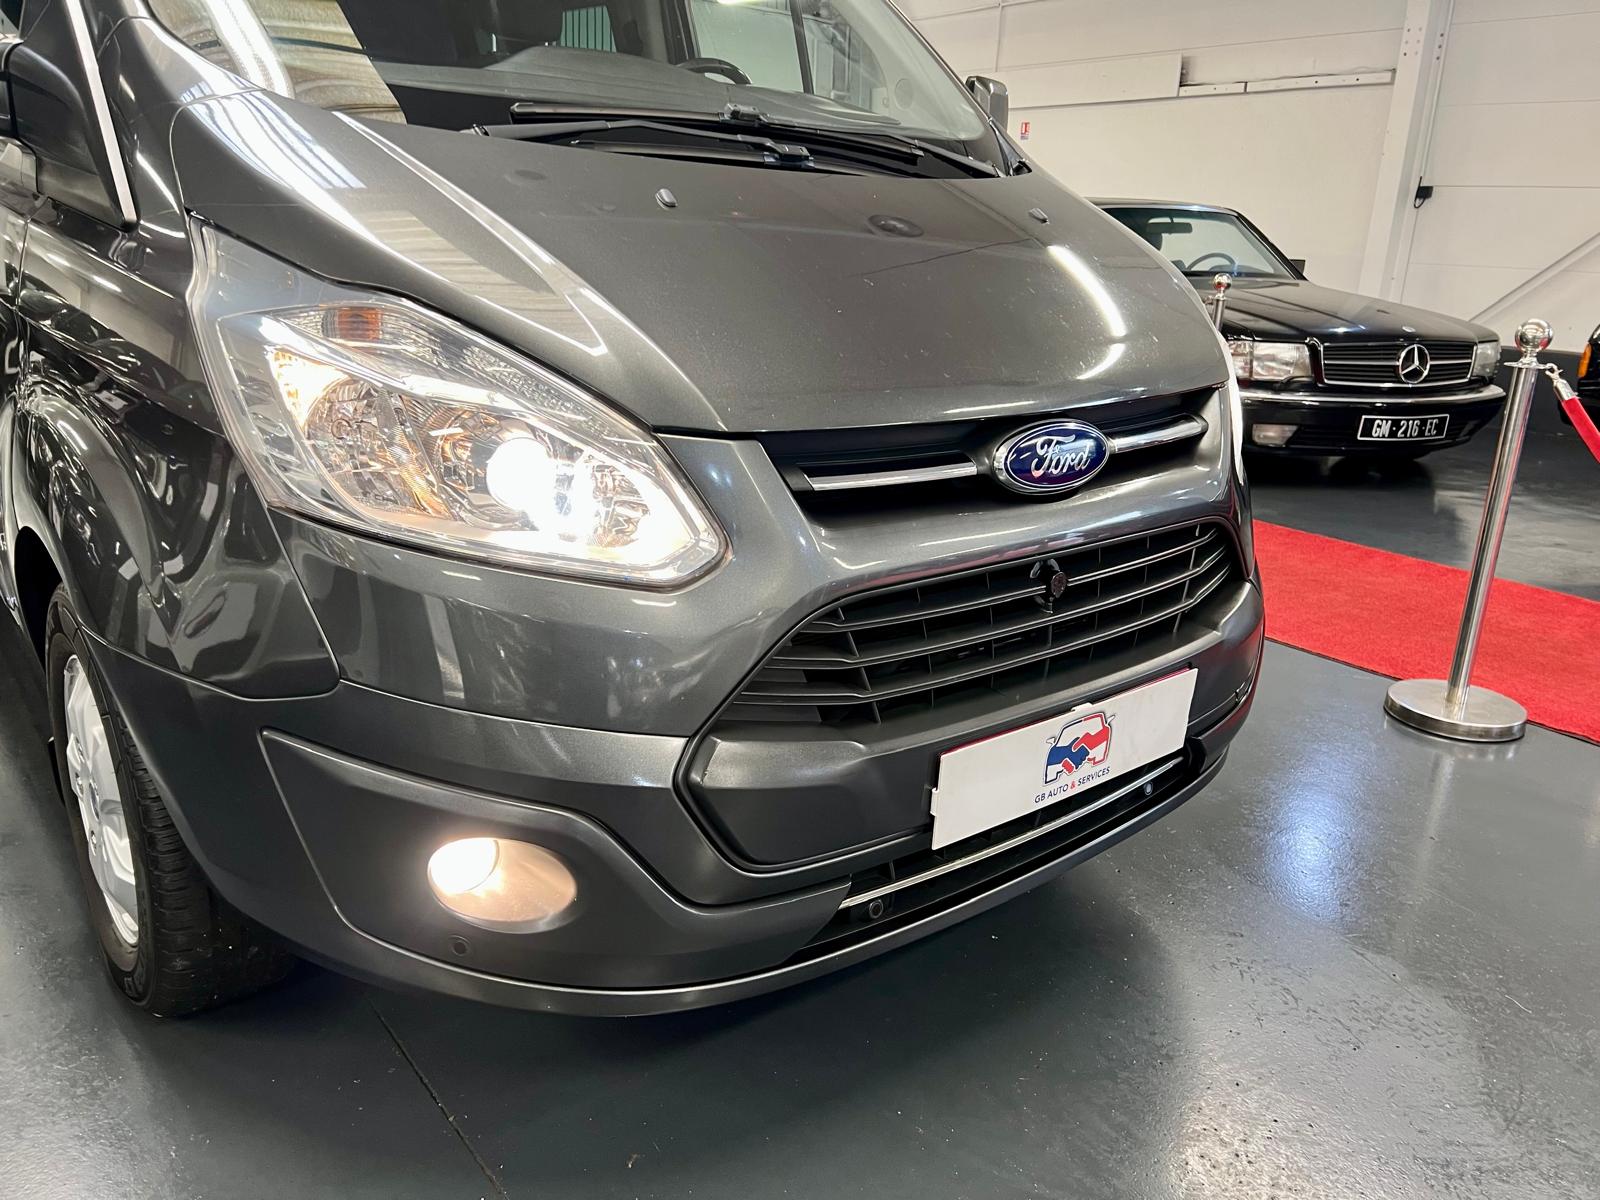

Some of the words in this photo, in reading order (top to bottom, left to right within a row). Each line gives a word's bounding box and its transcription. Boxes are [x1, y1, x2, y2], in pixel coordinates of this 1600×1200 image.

[1030, 434, 1091, 479] Ford
[1034, 792, 1046, 804] GB
[1047, 784, 1068, 799] AUTO
[1070, 780, 1076, 790] &
[1077, 766, 1110, 786] SERVICES
